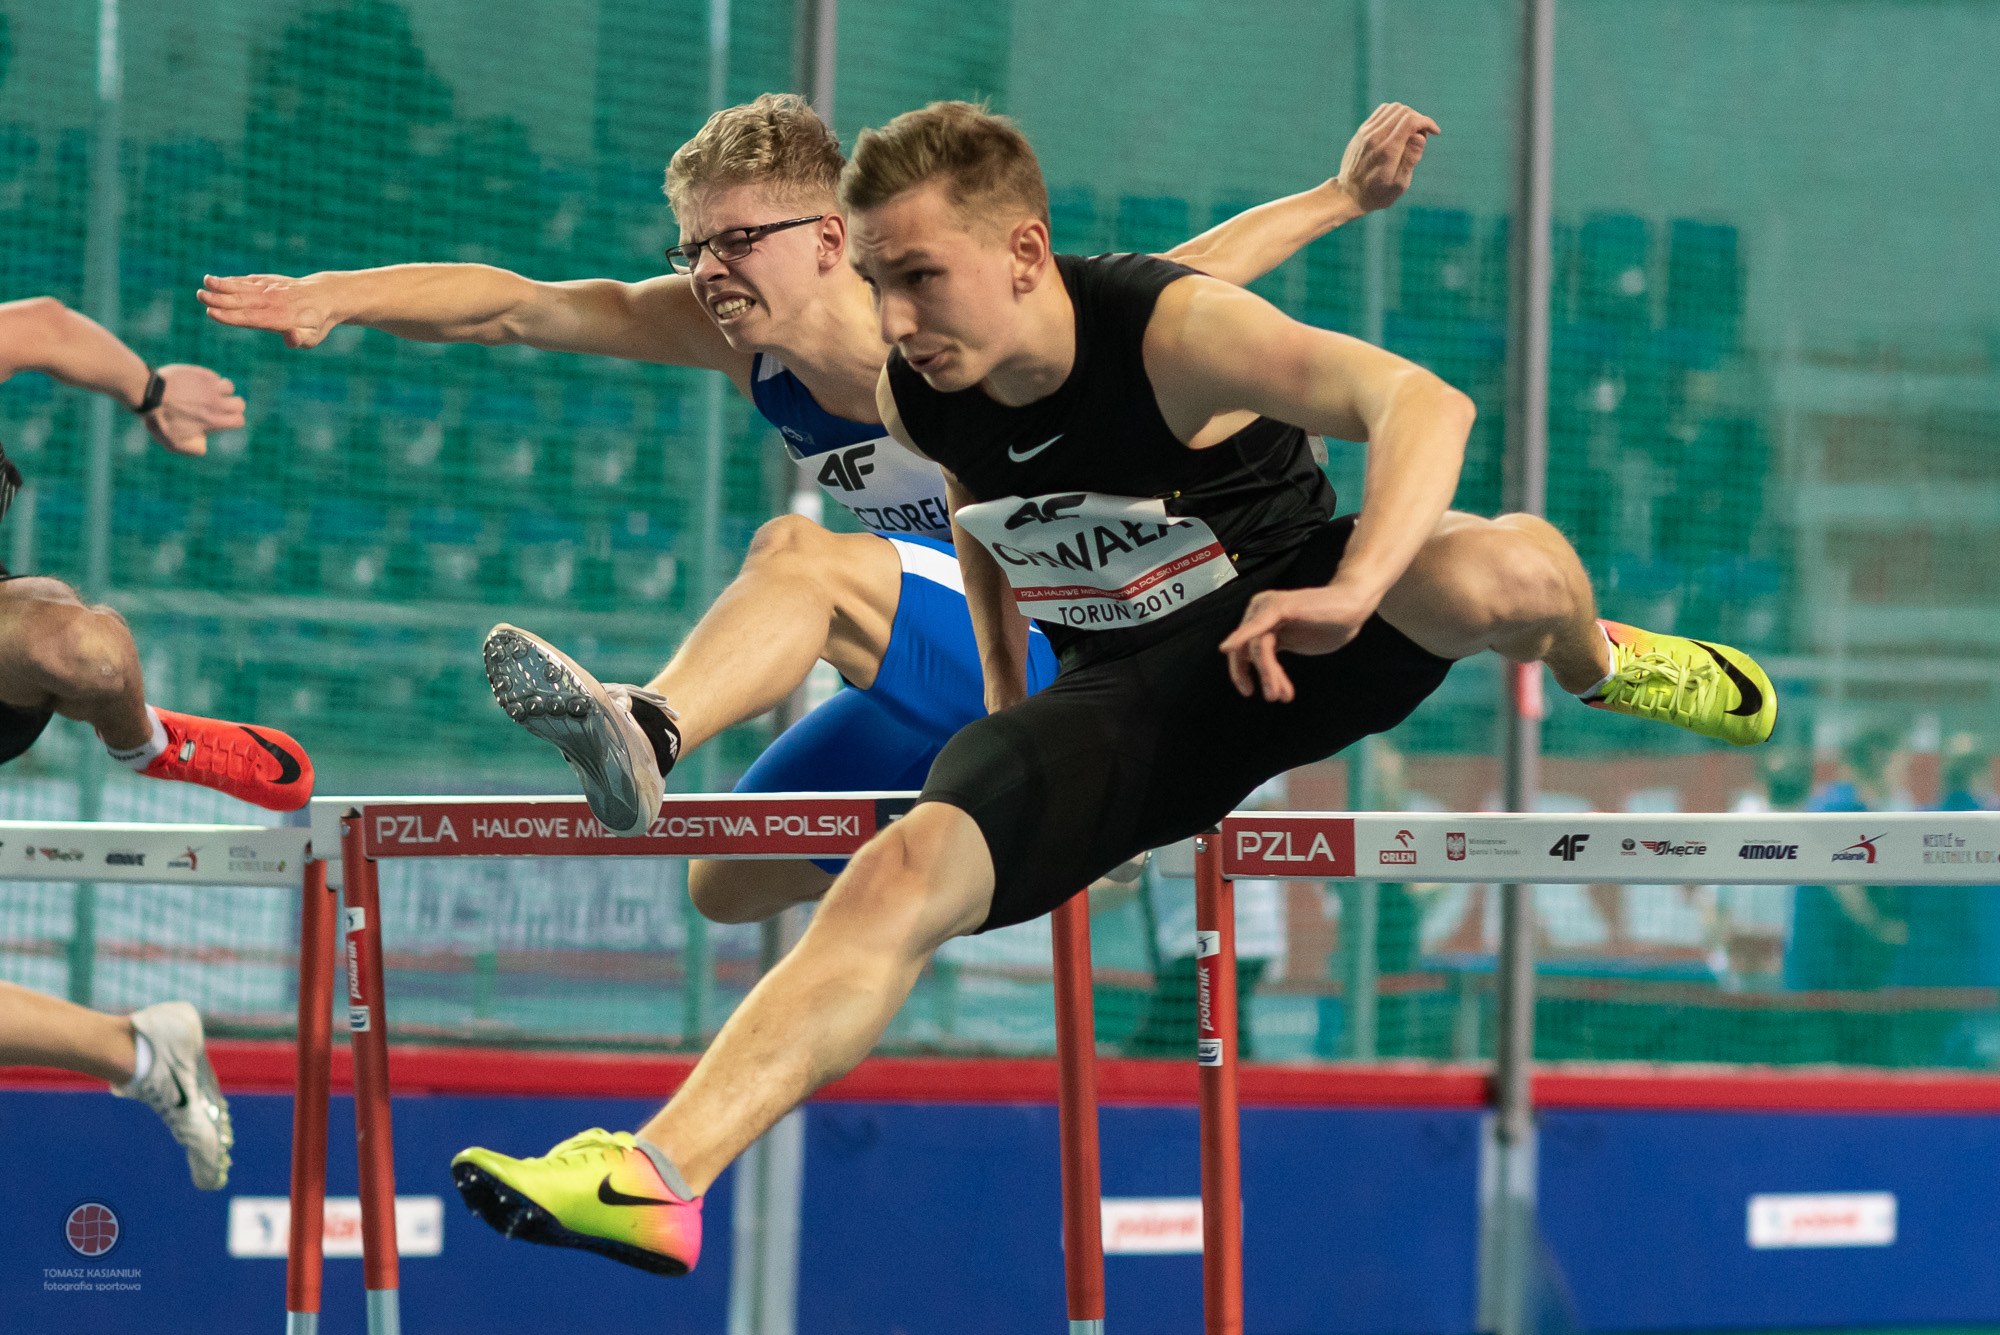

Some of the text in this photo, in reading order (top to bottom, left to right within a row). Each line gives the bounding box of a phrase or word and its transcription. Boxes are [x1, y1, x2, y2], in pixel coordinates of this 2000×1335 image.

[1044, 588, 1079, 596] HALOWE
[1139, 567, 1172, 588] POLSKI
[1173, 559, 1190, 571] U18
[1191, 551, 1211, 562] U20
[1058, 582, 1185, 625] TORUŃ 2019
[376, 815, 860, 843] PZLA HALOWE MIZOSTWA POLSKI
[1236, 831, 1335, 861] PZLA
[1381, 852, 1415, 863] ORLEN
[1549, 834, 1590, 861] 4F
[1738, 845, 1799, 859] 4MOVE
[1831, 852, 1866, 862] polanik
[1198, 967, 1214, 1031] polanik
